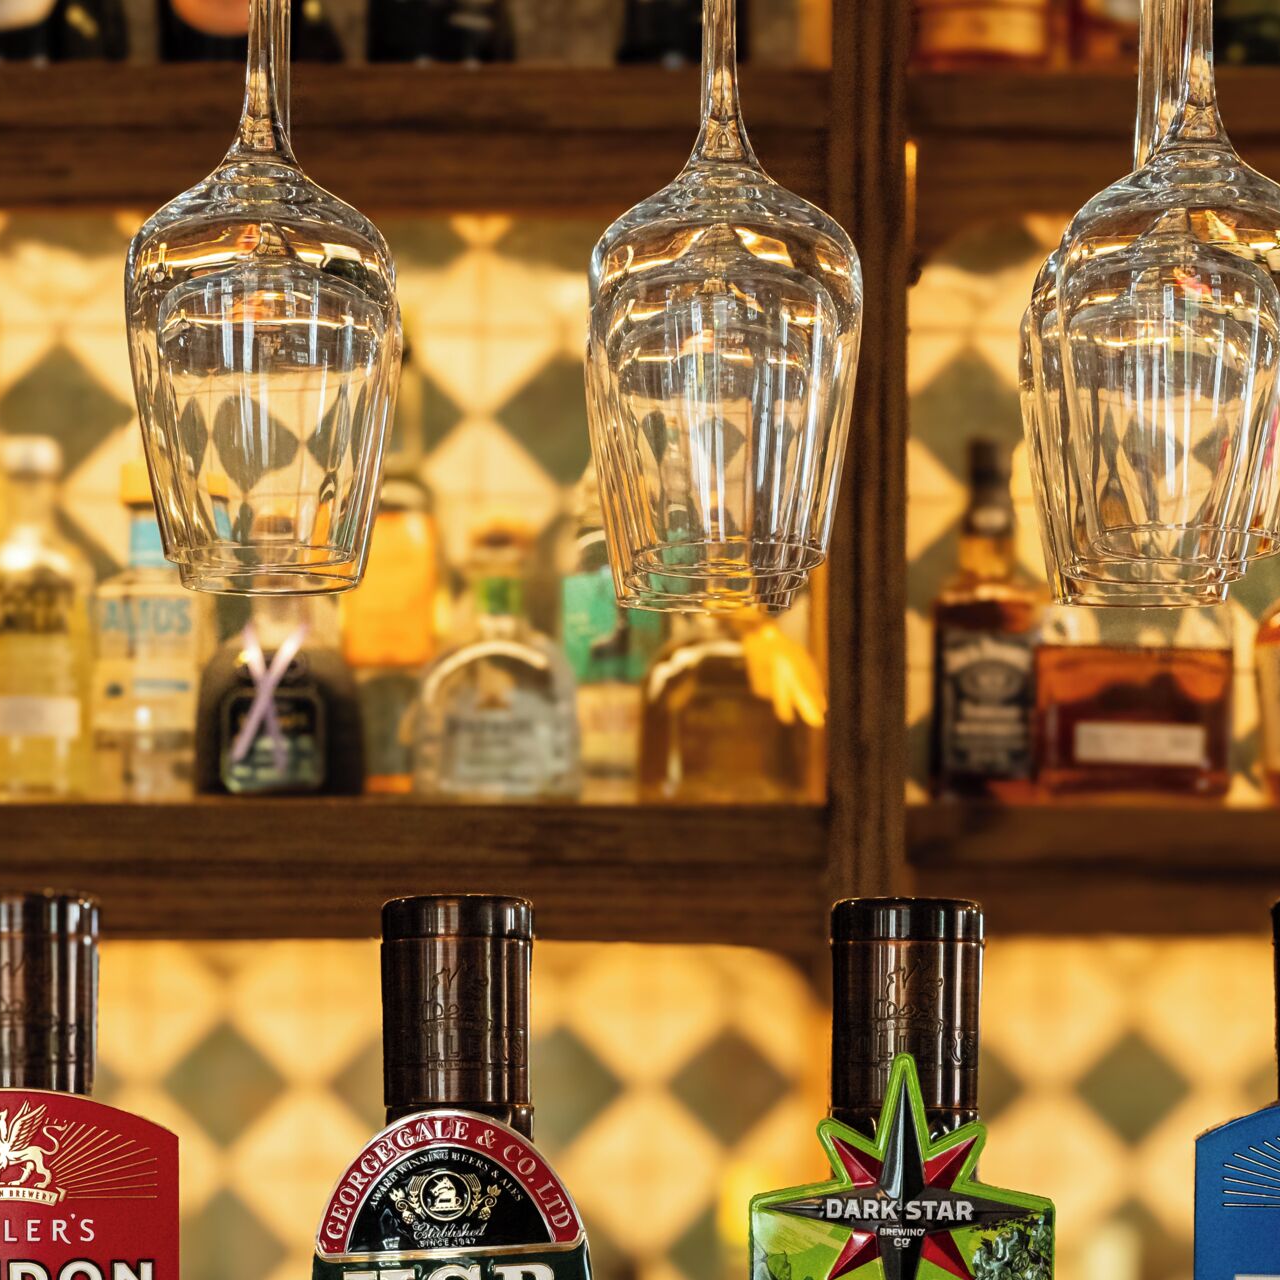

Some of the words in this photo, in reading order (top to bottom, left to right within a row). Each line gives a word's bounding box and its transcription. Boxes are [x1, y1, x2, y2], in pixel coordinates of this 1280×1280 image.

[325, 1139, 398, 1240] GEORGE
[396, 1119, 470, 1149] GALE
[475, 1129, 496, 1150] &
[535, 1181, 573, 1229] LTD
[396, 1151, 450, 1175] WINNING
[451, 1151, 490, 1172] BEERS
[490, 1170, 499, 1179] &
[499, 1178, 524, 1202] ALES
[9, 1189, 54, 1203] BREWERY
[825, 1198, 899, 1221] DARK
[905, 1200, 975, 1222] STAR
[412, 1221, 488, 1241] Established
[418, 1238, 450, 1249] SINCE
